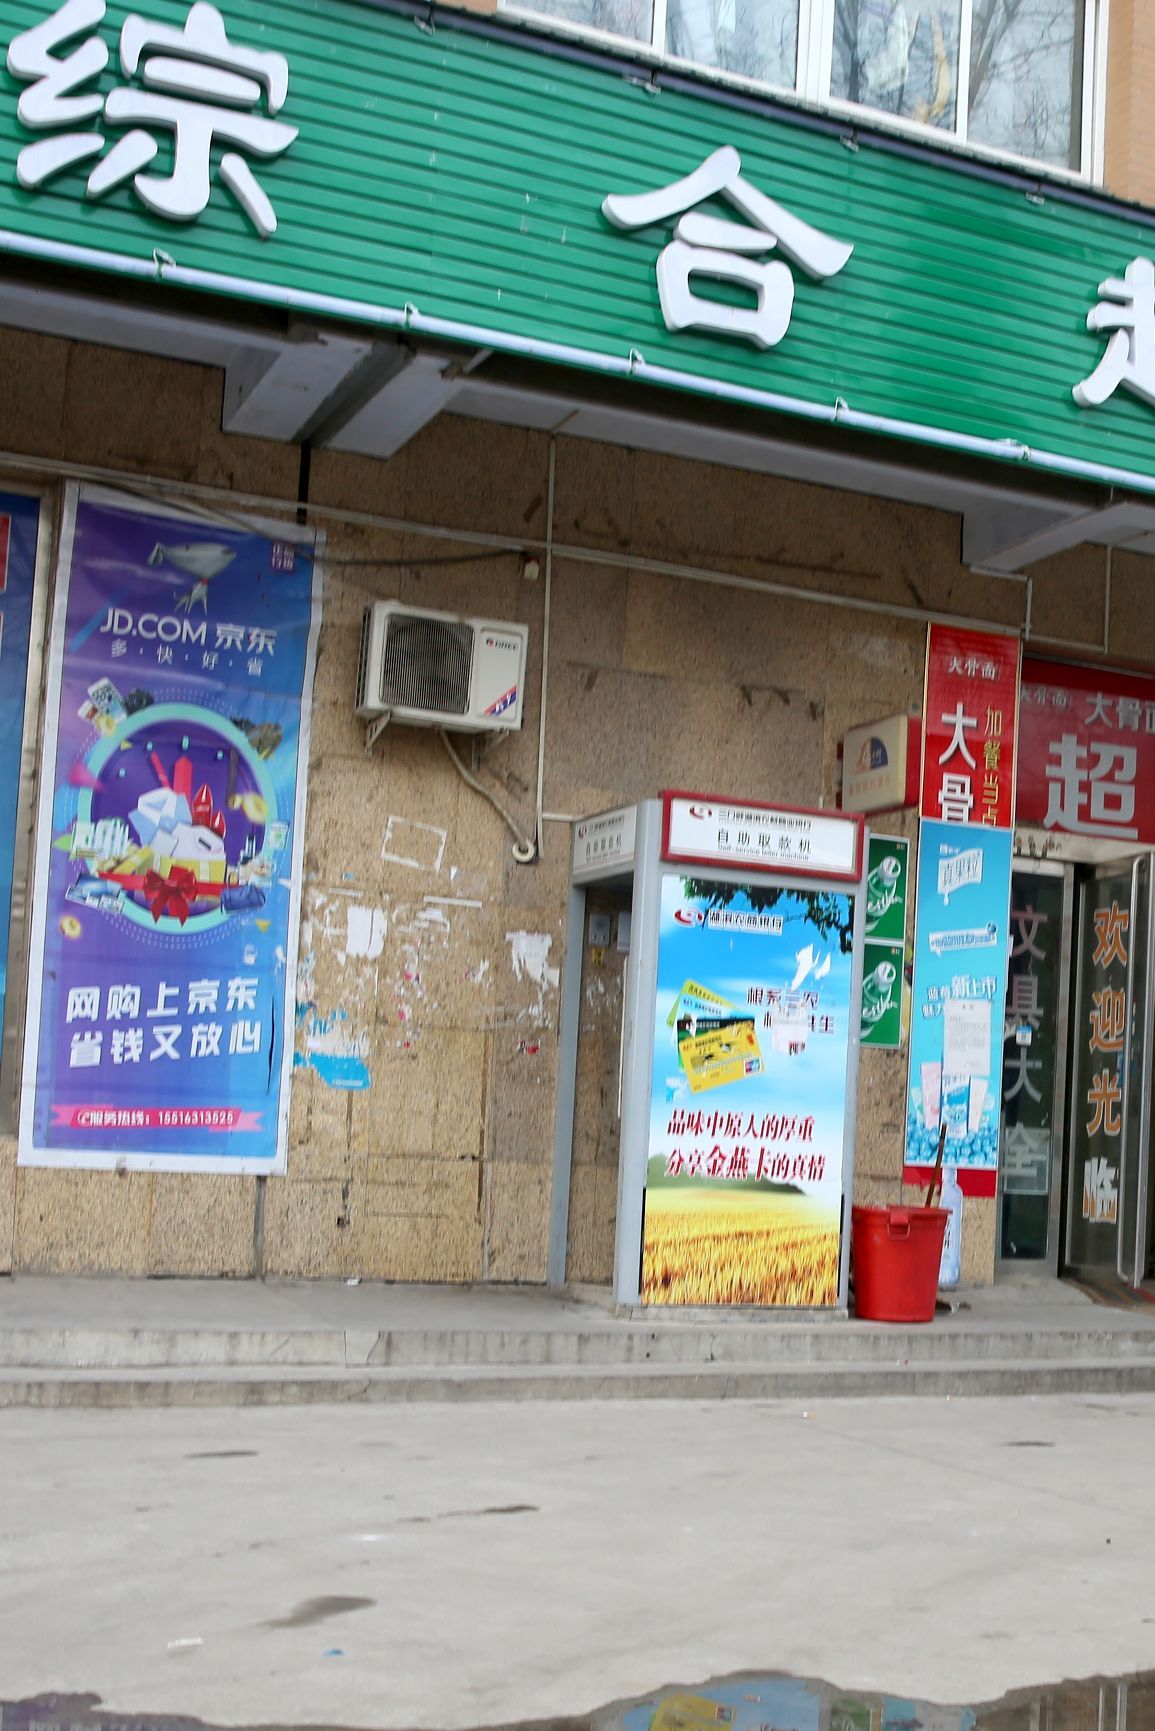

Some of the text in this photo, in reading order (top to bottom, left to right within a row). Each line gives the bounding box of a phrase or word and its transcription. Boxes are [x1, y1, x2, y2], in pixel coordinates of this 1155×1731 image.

[100, 607, 278, 656] JD.COM 京东
[718, 828, 811, 854] 自助取款机
[66, 976, 259, 1023] 网购上京东
[69, 1019, 262, 1068] 省钱又放心
[1003, 904, 1048, 1179] 文具大全
[1083, 900, 1129, 1224] 欢迎光临
[665, 1107, 816, 1143] 品味中原人的厚重
[664, 1143, 826, 1182] 分享金燕卡的真情
